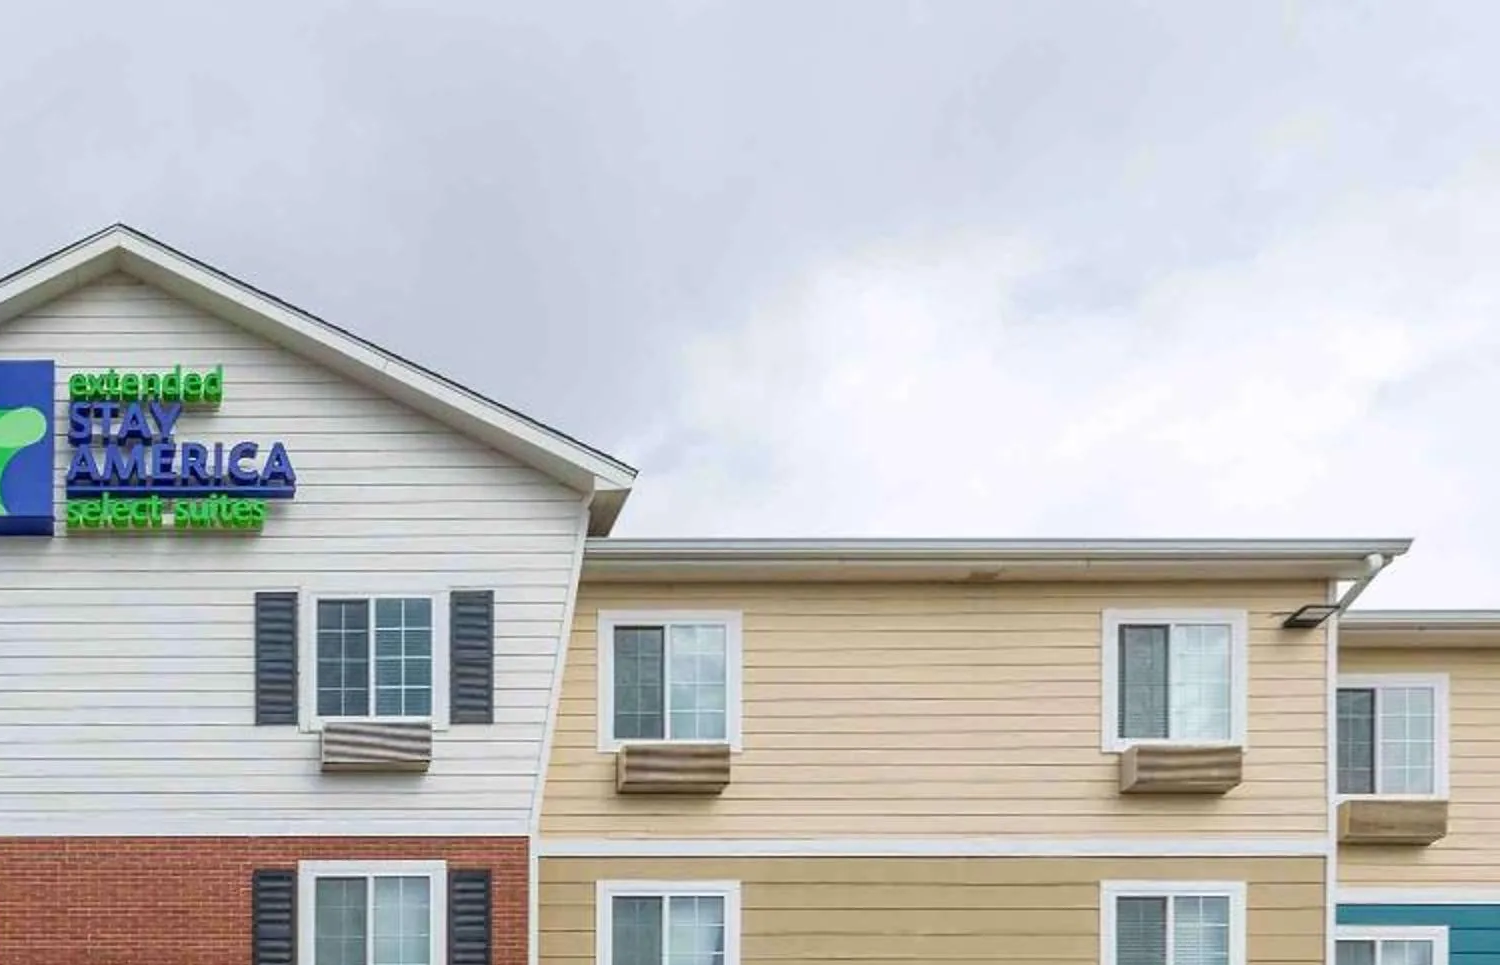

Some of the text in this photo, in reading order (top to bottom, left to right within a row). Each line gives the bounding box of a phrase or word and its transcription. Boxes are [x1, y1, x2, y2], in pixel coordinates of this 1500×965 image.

[68, 364, 223, 401] extended
[68, 401, 182, 443] STAY
[67, 441, 296, 485] AMERICA
[67, 493, 267, 528] select suites
